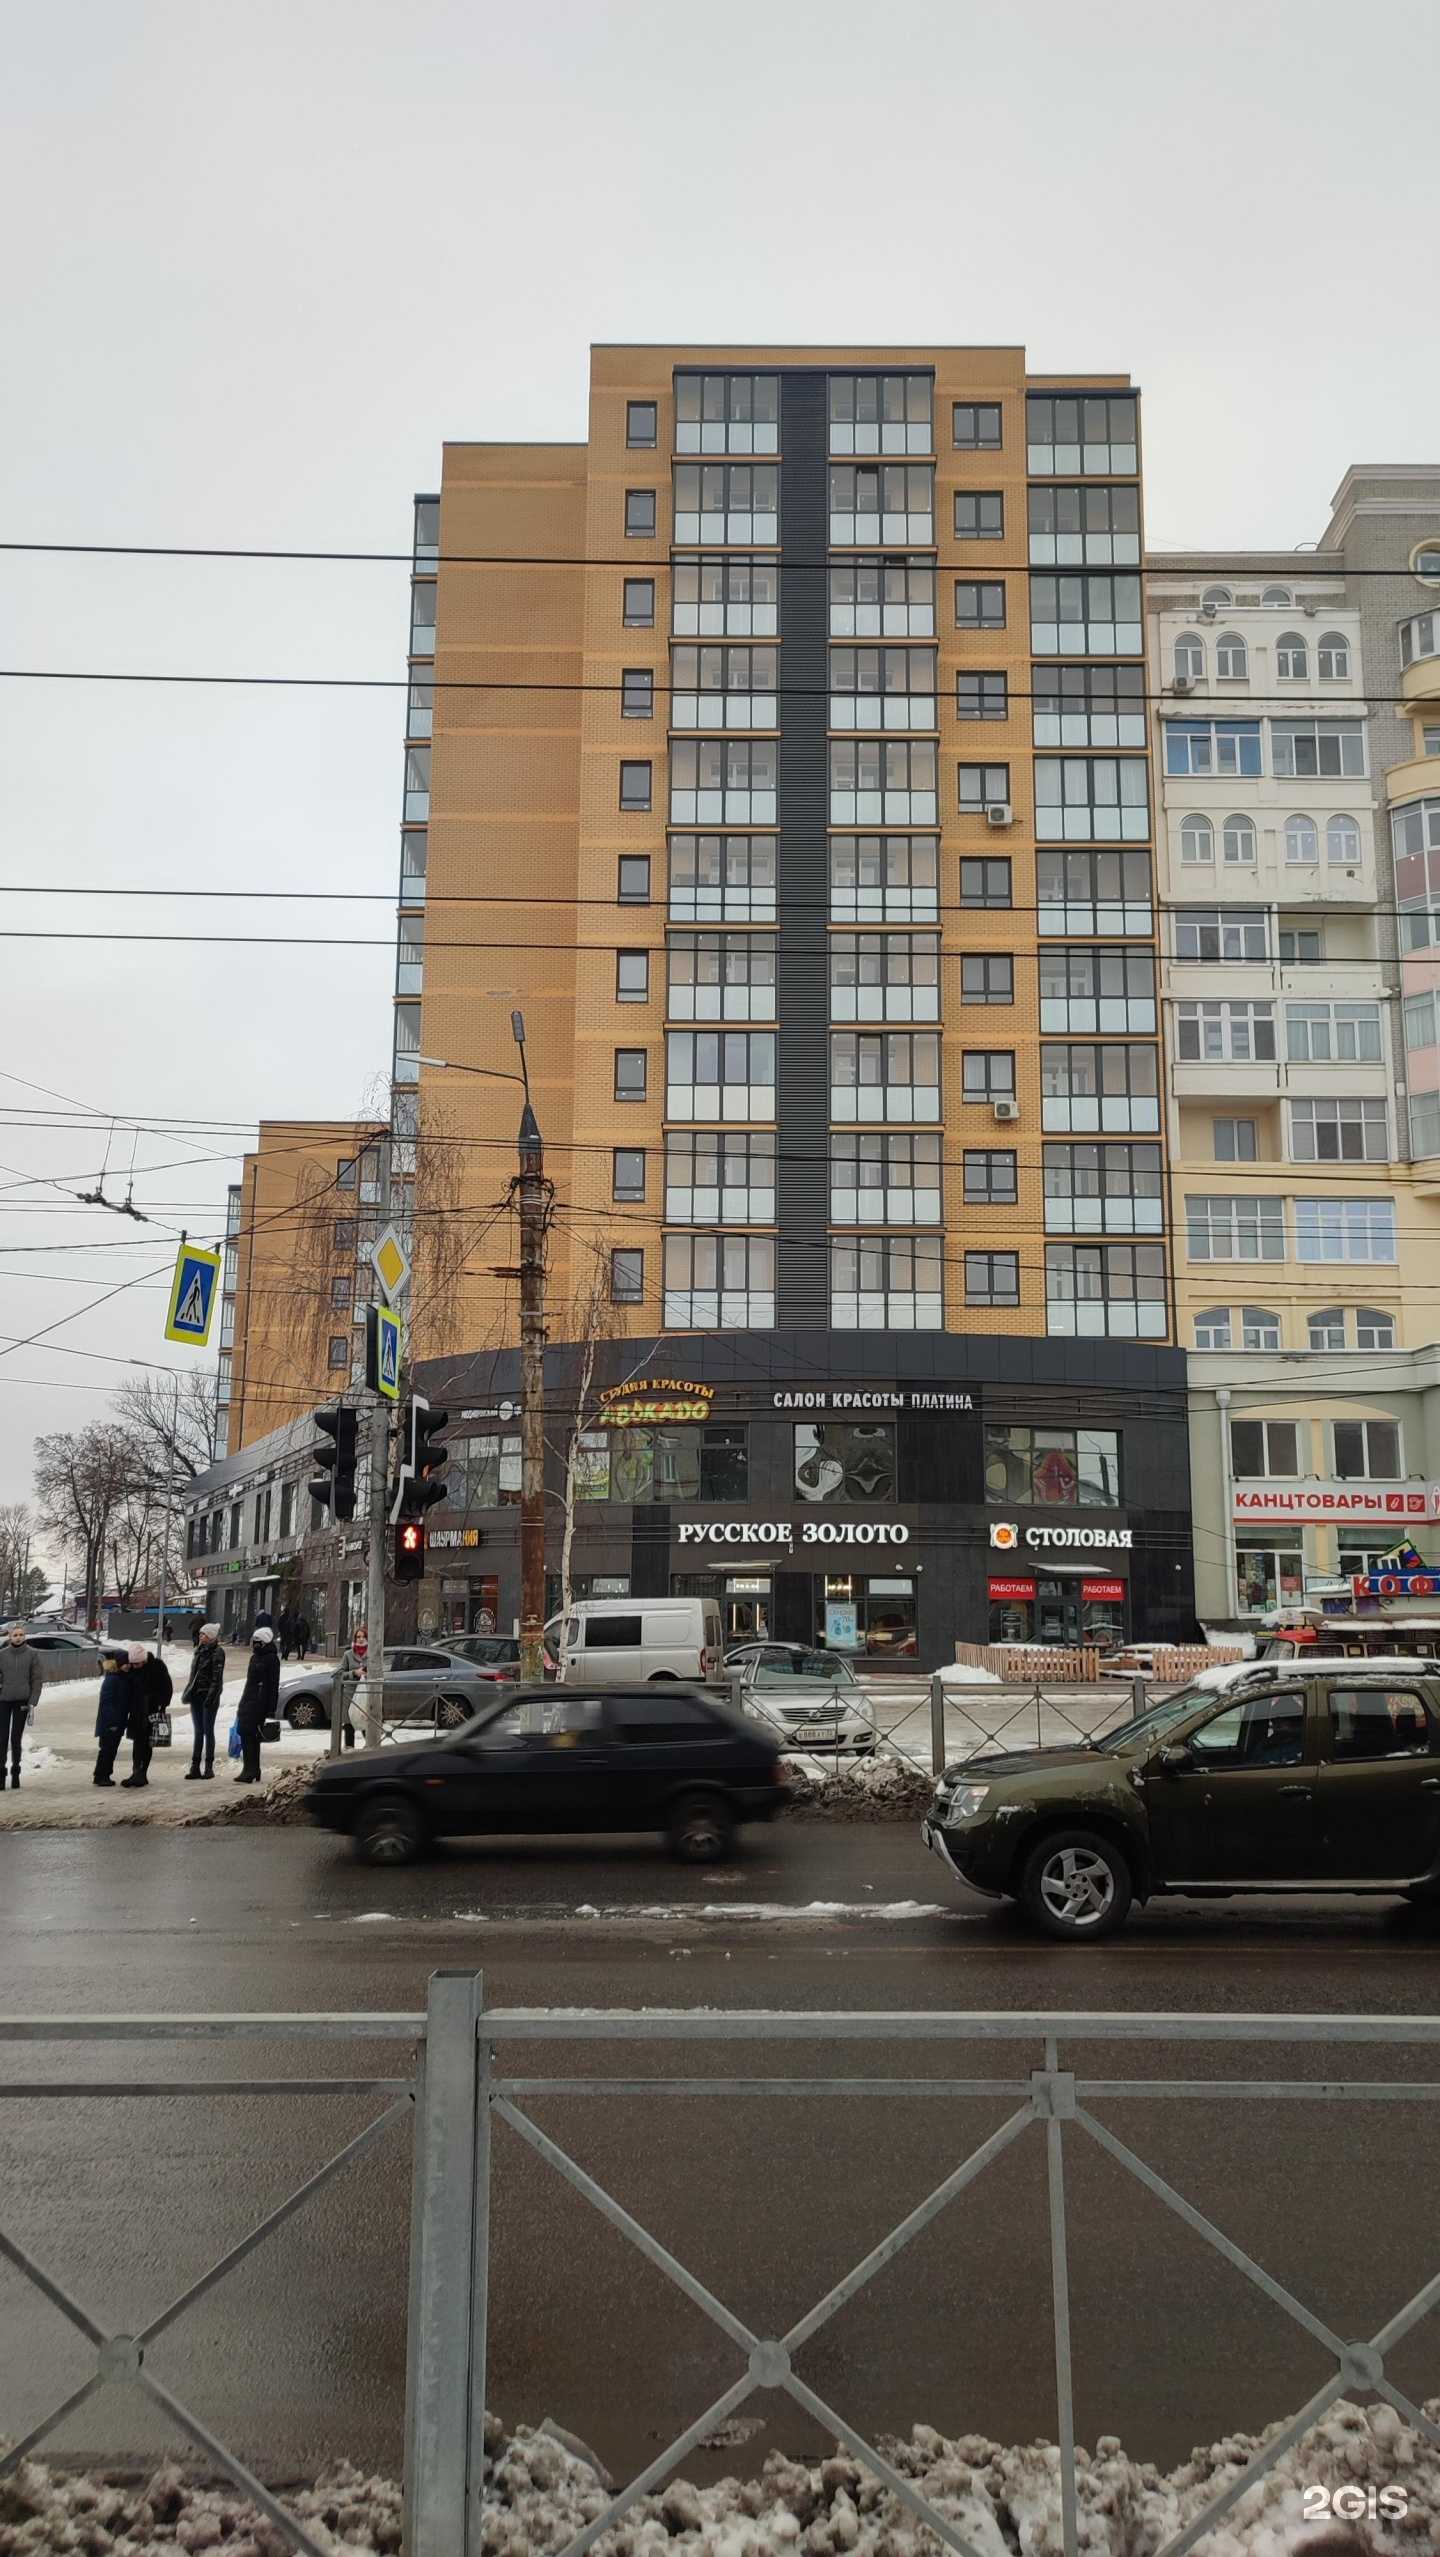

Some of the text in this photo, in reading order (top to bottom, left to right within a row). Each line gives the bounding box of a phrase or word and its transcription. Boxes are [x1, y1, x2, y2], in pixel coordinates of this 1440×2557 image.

[652, 1379, 715, 1399] КРАСОТЫ
[773, 1392, 973, 1410] САЛОН КРАСОТЫ ПЛАТИНА
[1235, 1493, 1382, 1510] КАНЦТОВАРЫ
[429, 1529, 479, 1548] ШАУРМАНИЯ
[678, 1523, 909, 1543] РУССКОЕ ЗОЛОТО
[1025, 1527, 1133, 1548] СТОЛОВАЯ
[990, 1583, 1033, 1593] РАБОТАЕМ
[1082, 1584, 1122, 1594] РАБОТАЕМ
